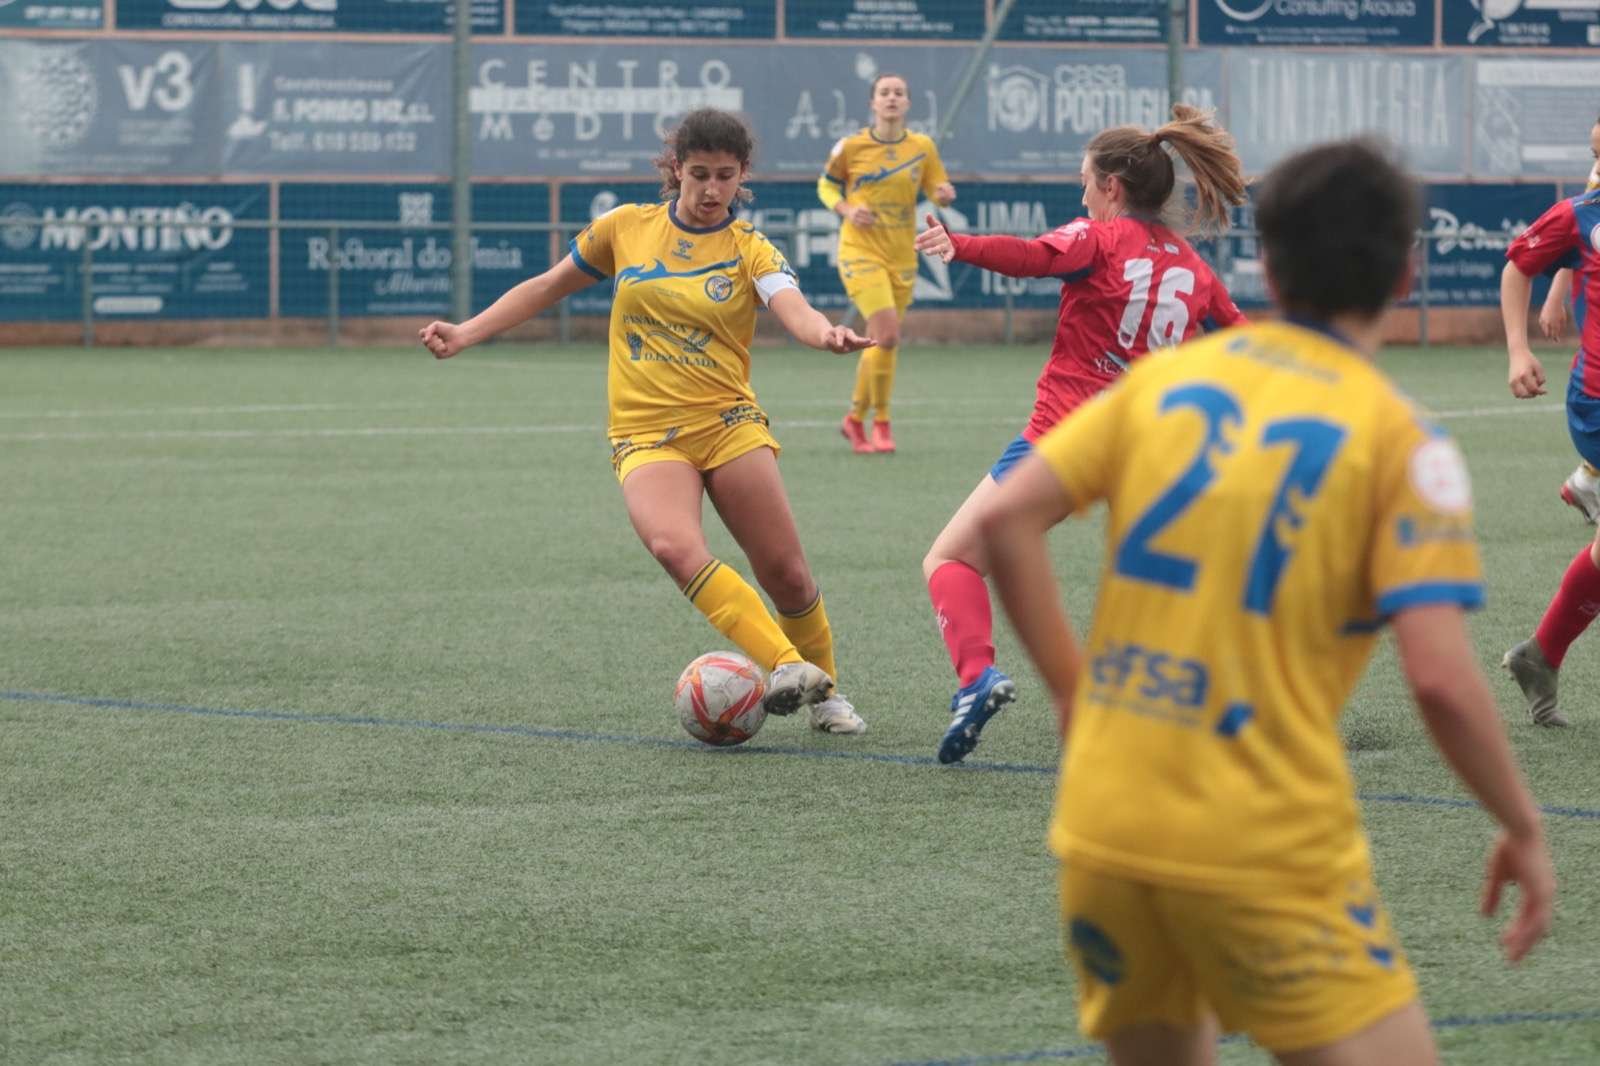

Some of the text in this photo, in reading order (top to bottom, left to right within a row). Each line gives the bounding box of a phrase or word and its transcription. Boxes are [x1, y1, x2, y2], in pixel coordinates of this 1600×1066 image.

[117, 50, 194, 111] v3
[479, 59, 732, 90] CENTRO
[40, 200, 234, 251] MONTIÑO
[417, 236, 452, 270] do
[1117, 257, 1196, 352] 16
[1113, 384, 1349, 617] 21
